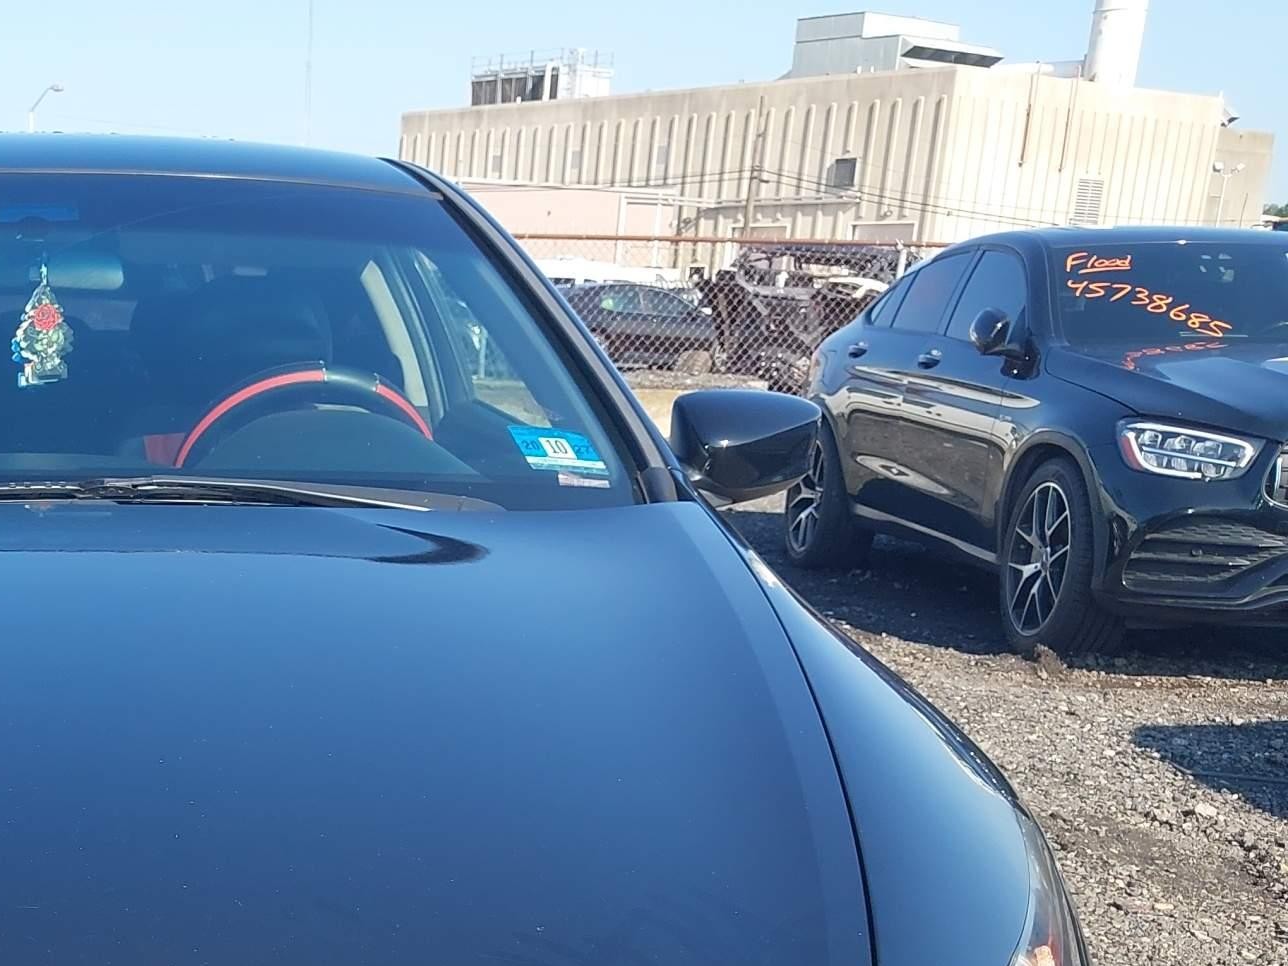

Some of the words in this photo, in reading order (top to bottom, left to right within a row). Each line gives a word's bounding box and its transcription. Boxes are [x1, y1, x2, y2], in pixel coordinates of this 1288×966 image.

[1064, 252, 1132, 273] Flood
[1066, 279, 1233, 338] 45738685
[521, 439, 541, 450] 20
[545, 439, 569, 455] 10
